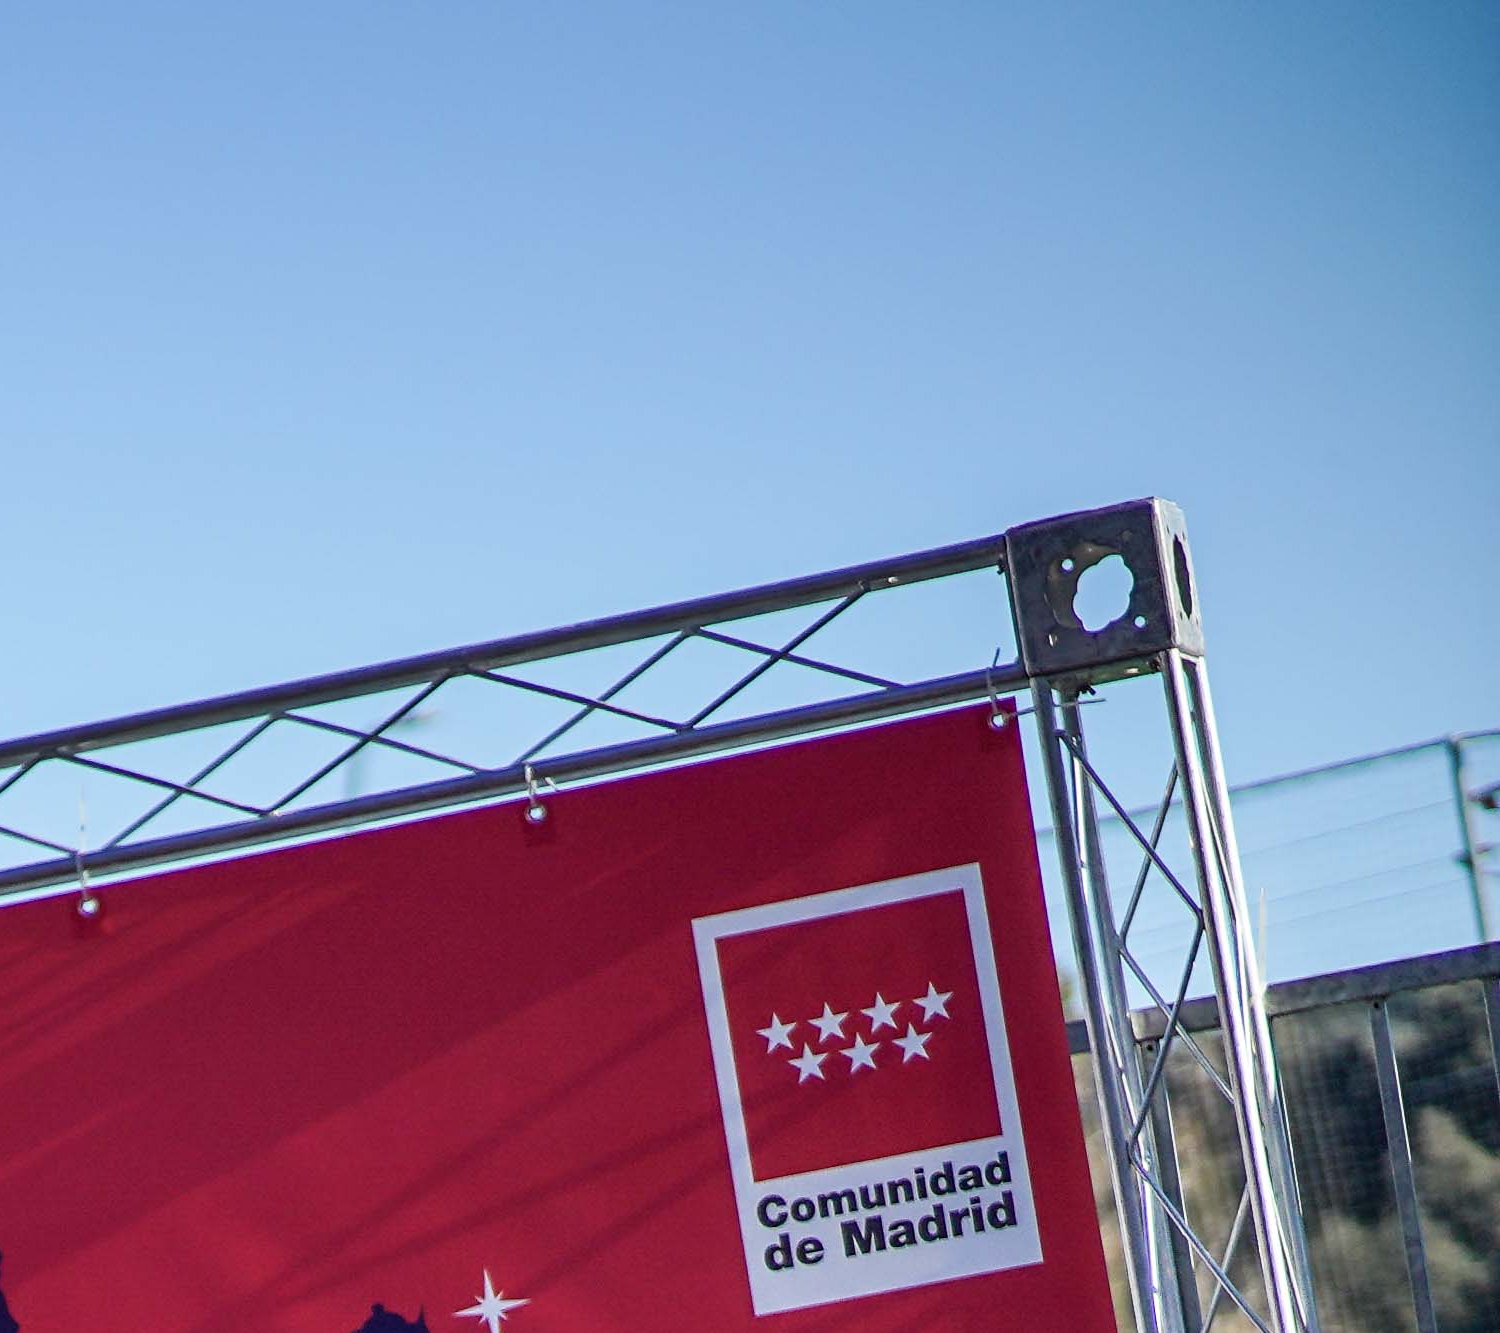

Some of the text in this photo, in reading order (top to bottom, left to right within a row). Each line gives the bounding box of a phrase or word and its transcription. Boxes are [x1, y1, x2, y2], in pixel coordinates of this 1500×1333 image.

[757, 1151, 1012, 1228] Comunidad
[764, 1190, 1017, 1271] de Madrid
